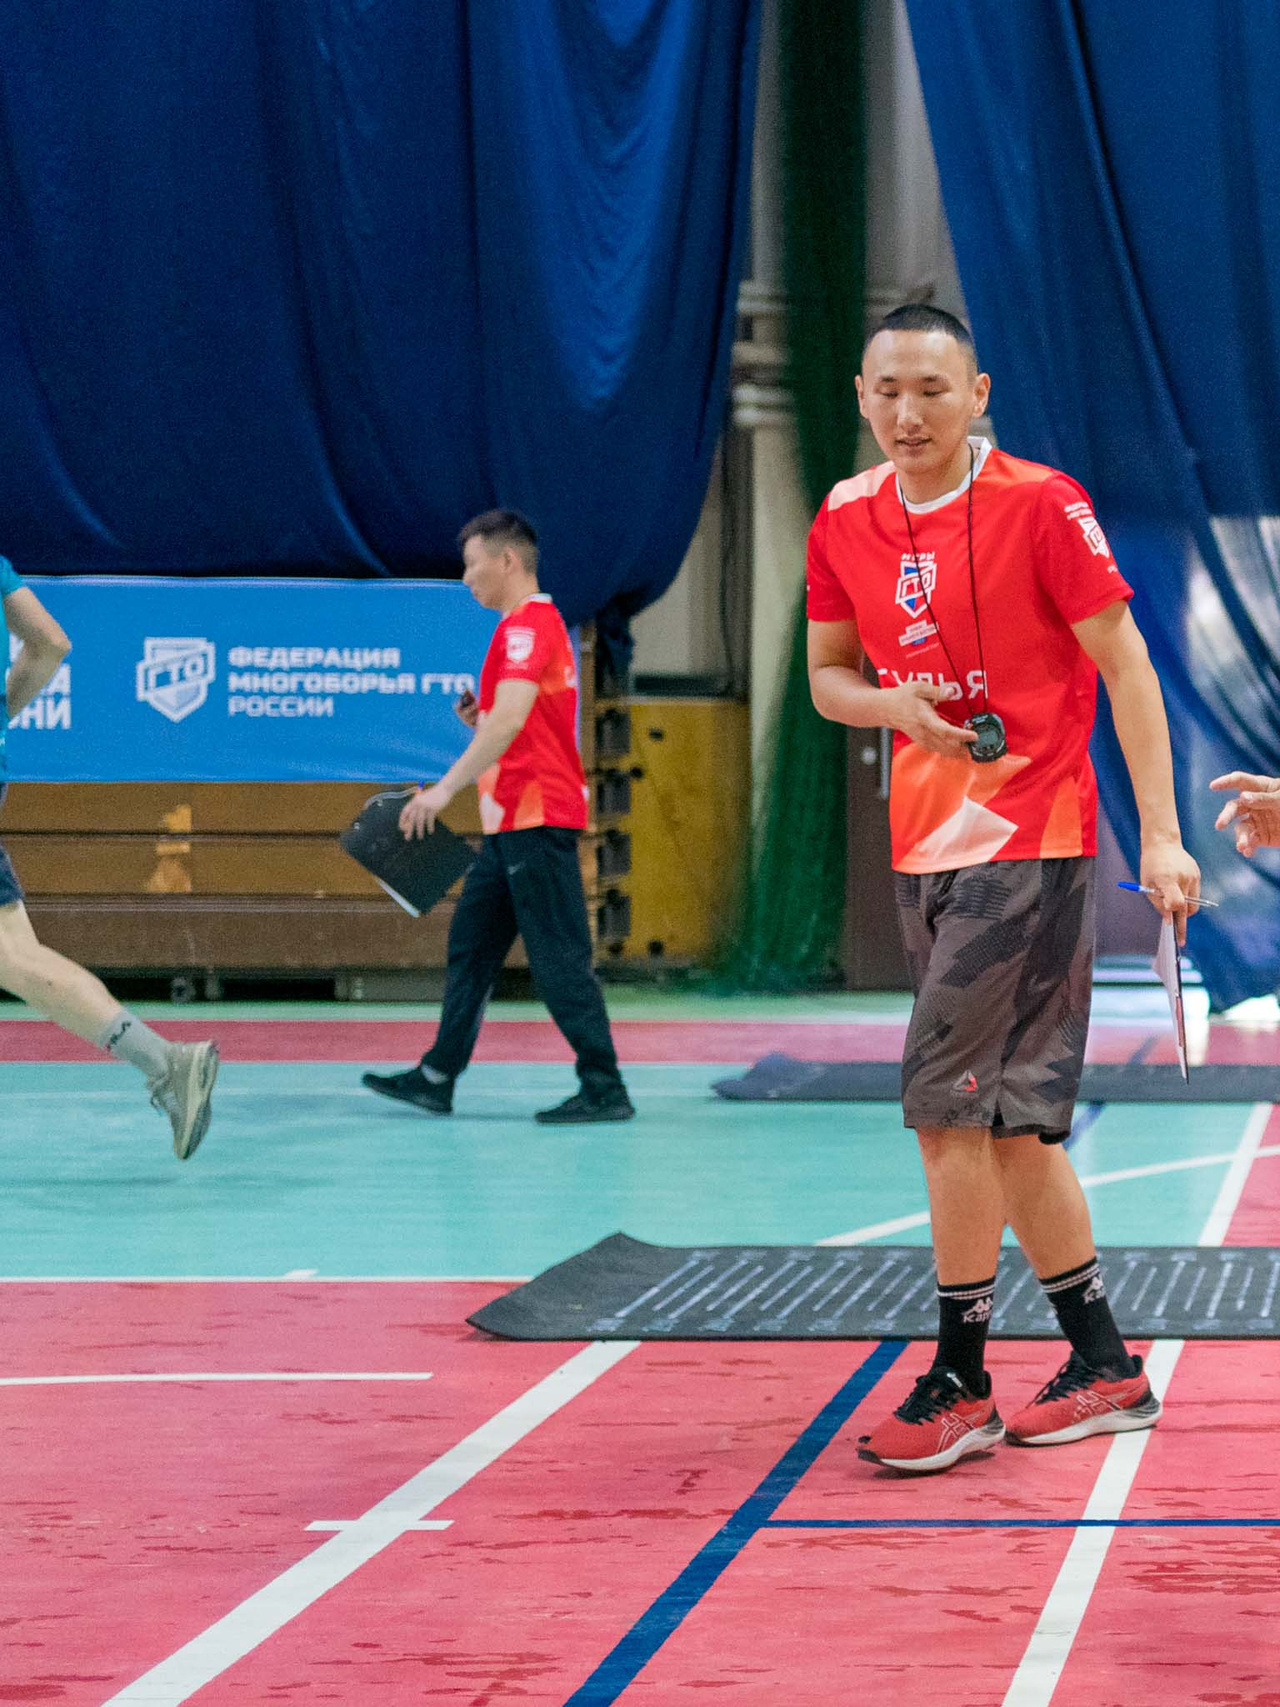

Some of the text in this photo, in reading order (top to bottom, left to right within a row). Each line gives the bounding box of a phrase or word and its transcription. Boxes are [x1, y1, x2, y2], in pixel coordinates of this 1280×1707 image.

[902, 572, 931, 597] ГТО
[150, 652, 205, 689] ГТО
[229, 646, 399, 671] ФЕДЕРАЦИЯ
[229, 672, 475, 694] МНОГОБОРЬЯ ГТО
[229, 696, 334, 717] РОССИИ
